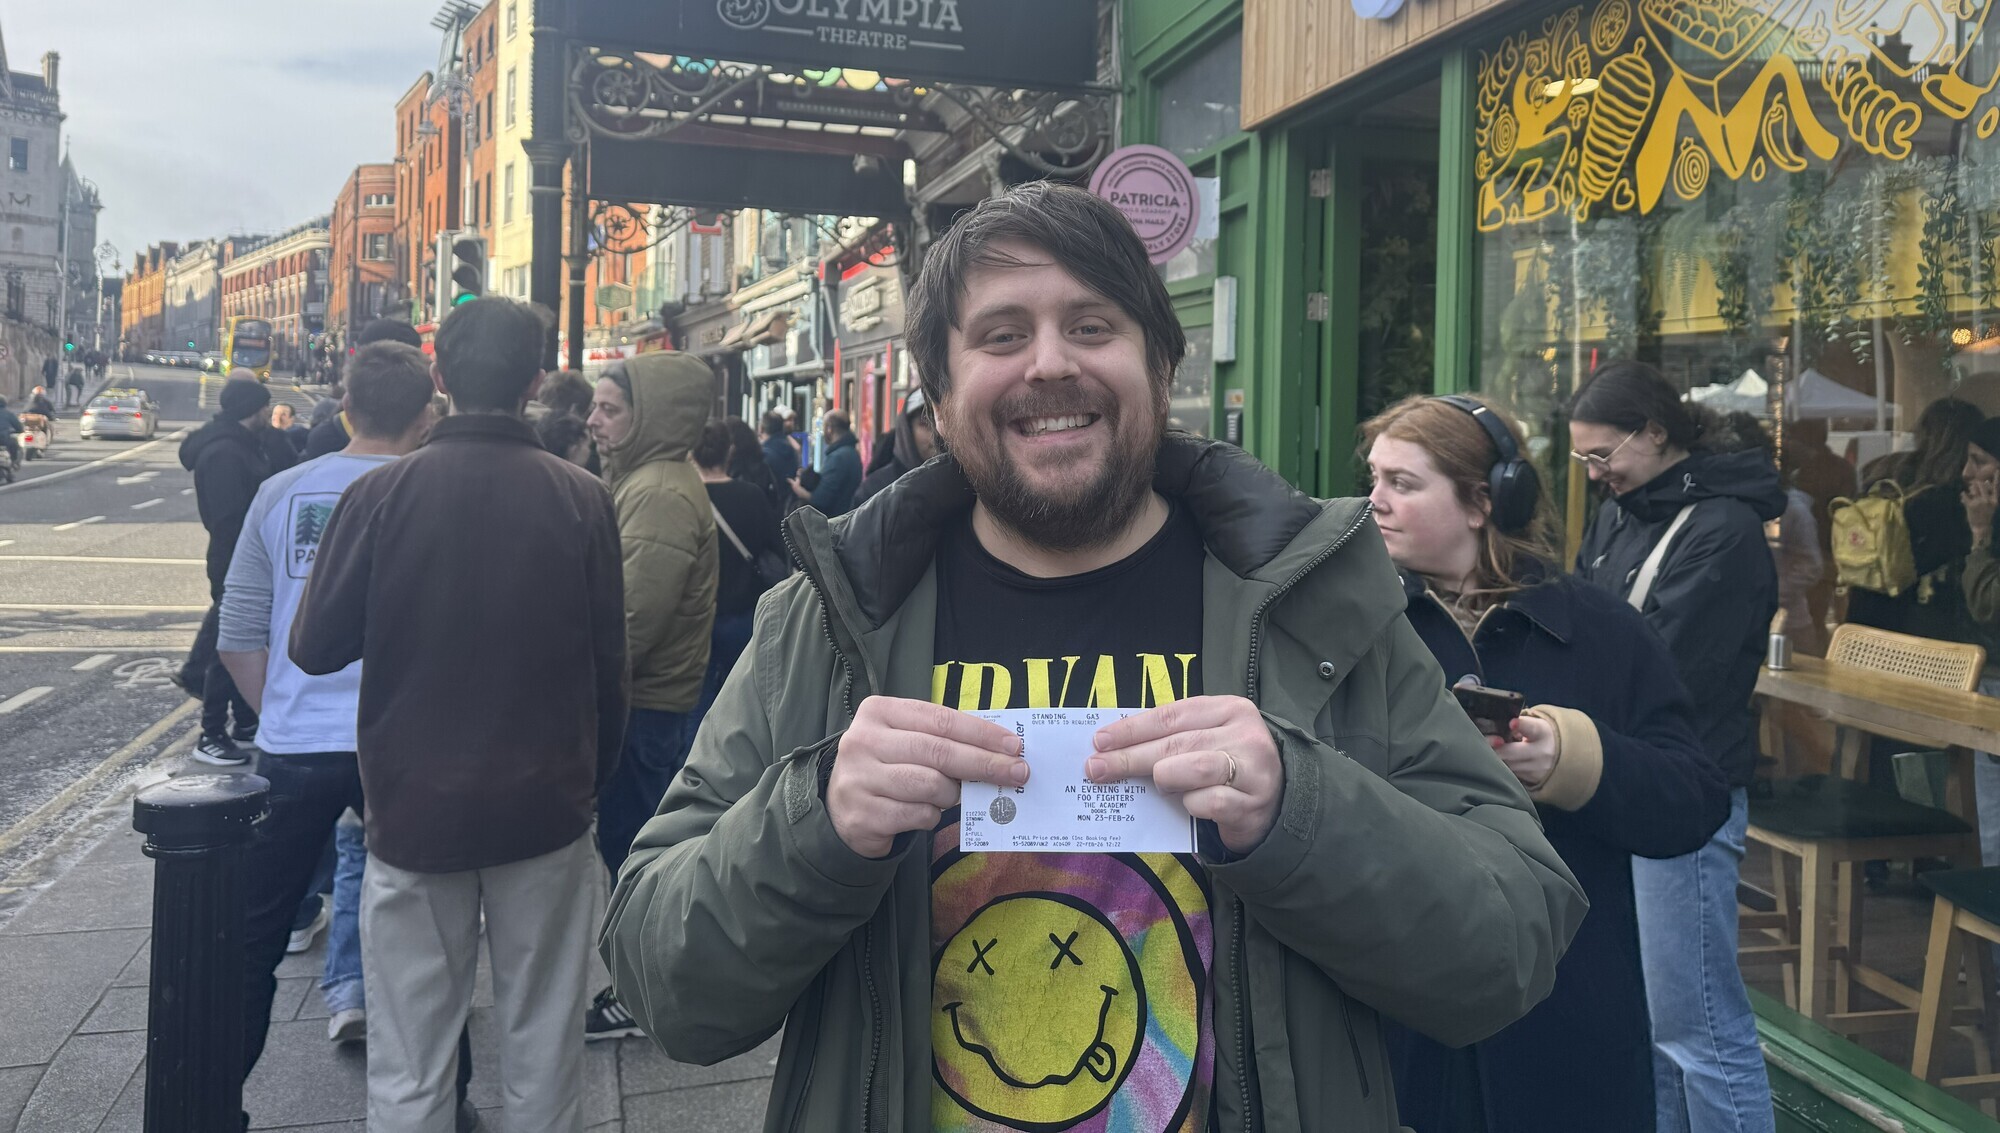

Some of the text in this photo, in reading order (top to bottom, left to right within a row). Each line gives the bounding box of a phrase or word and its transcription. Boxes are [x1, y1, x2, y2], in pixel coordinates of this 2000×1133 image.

[816, 26, 907, 49] THEATRE
[1110, 191, 1180, 207] PATRICIA
[1165, 216, 1186, 243] STORE
[295, 548, 318, 564] PA
[1065, 785, 1146, 794] AN EVENING WITH
